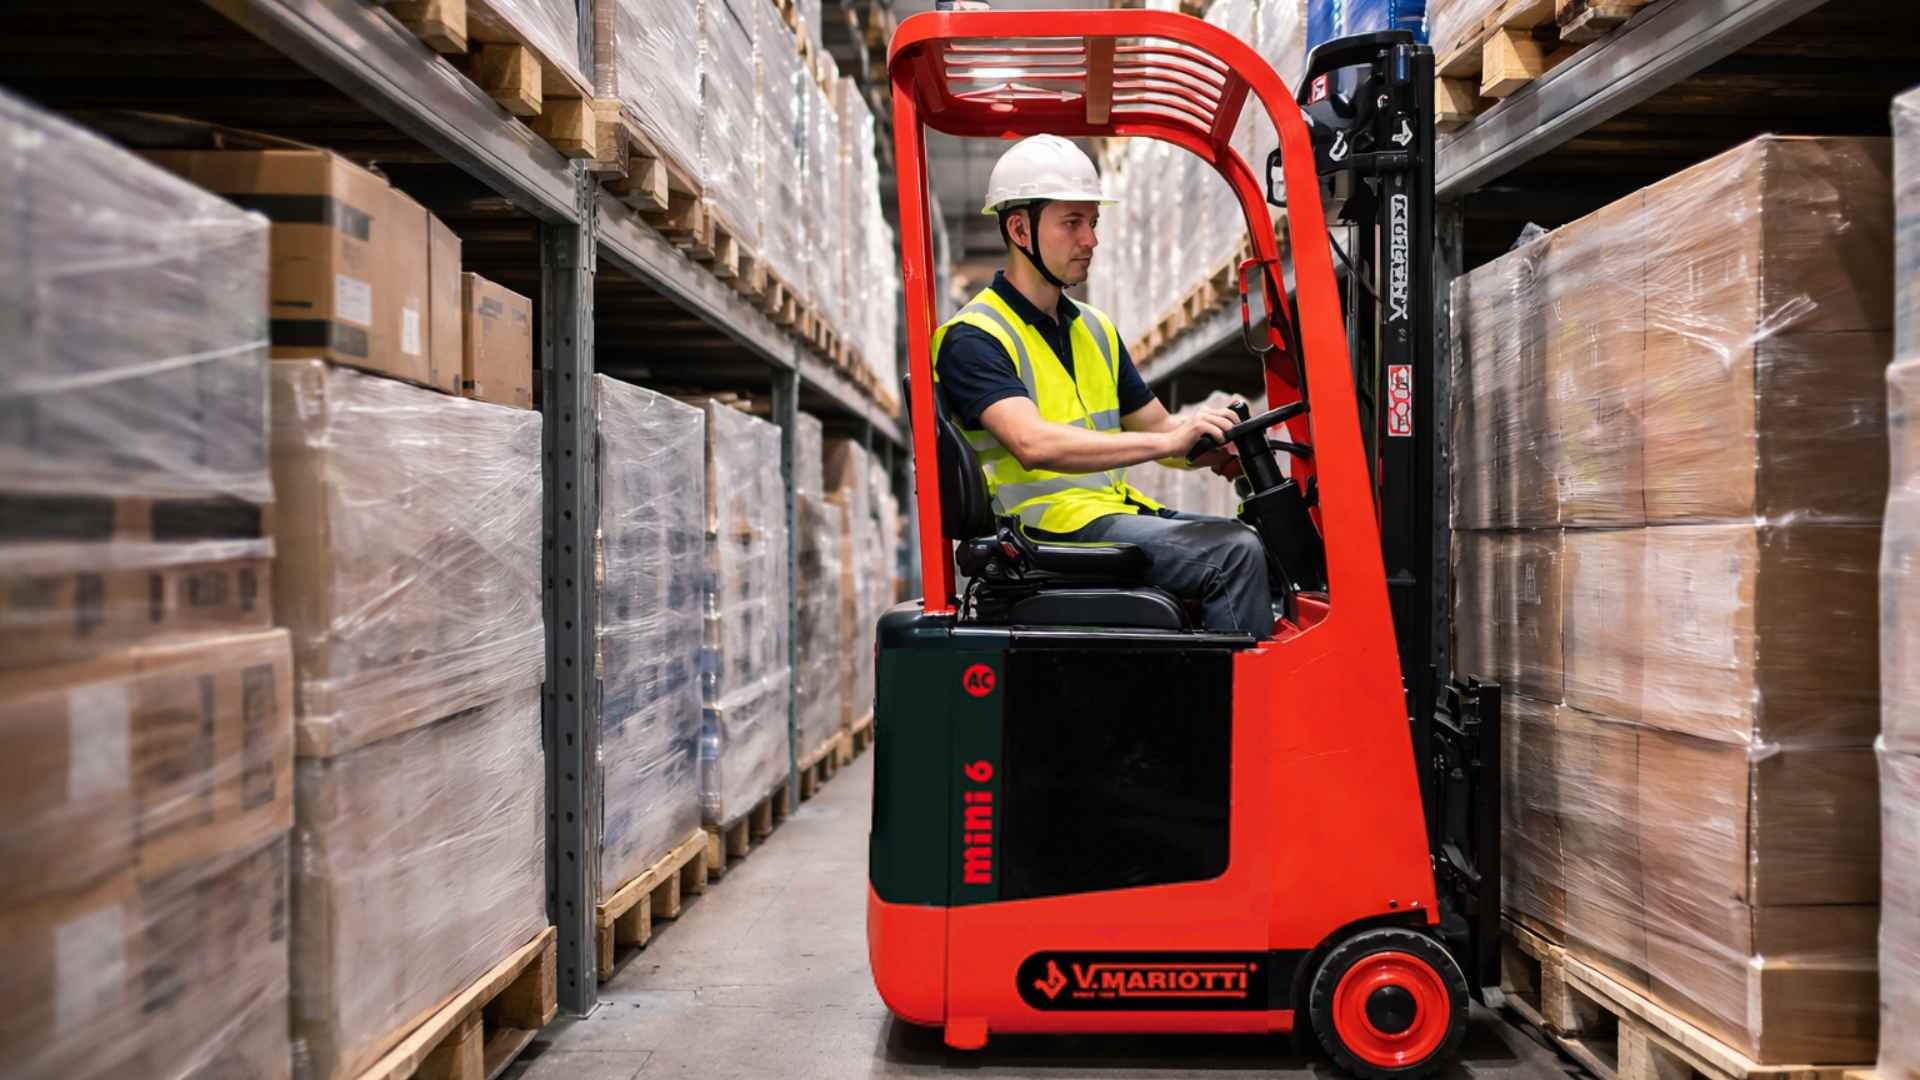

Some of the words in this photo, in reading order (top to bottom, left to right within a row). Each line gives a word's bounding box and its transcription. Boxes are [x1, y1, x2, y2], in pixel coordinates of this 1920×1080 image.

[968, 671, 993, 689] AC
[963, 760, 994, 783] 6
[963, 791, 993, 884] mini
[1072, 963, 1248, 993] V.MARIOTTI
